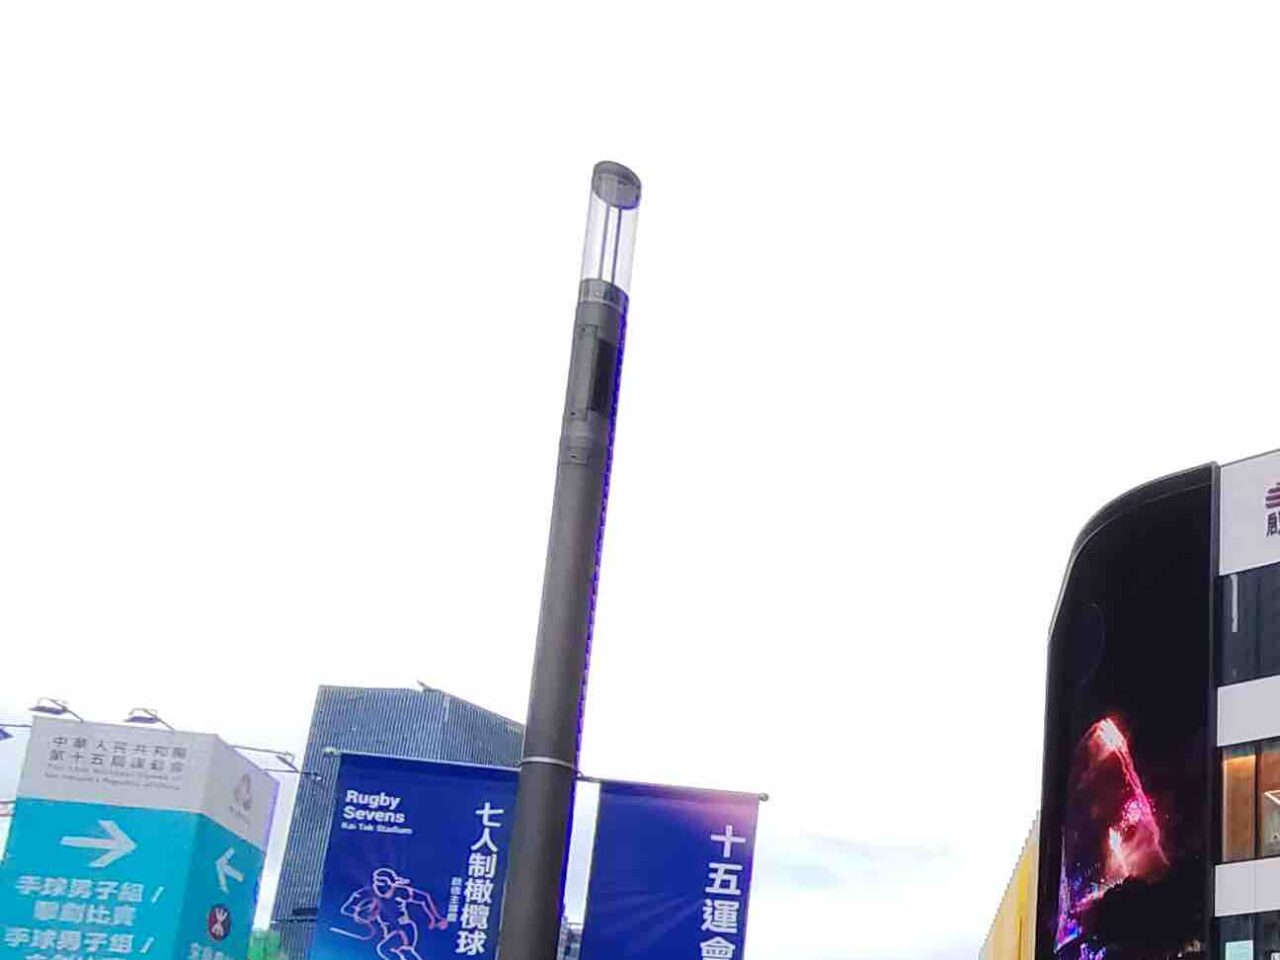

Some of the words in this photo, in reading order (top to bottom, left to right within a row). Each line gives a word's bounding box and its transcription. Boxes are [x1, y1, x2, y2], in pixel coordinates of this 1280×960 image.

[345, 789, 400, 810] Rugby
[343, 805, 405, 823] Sevens
[455, 802, 504, 956] 七人制橄欖球
